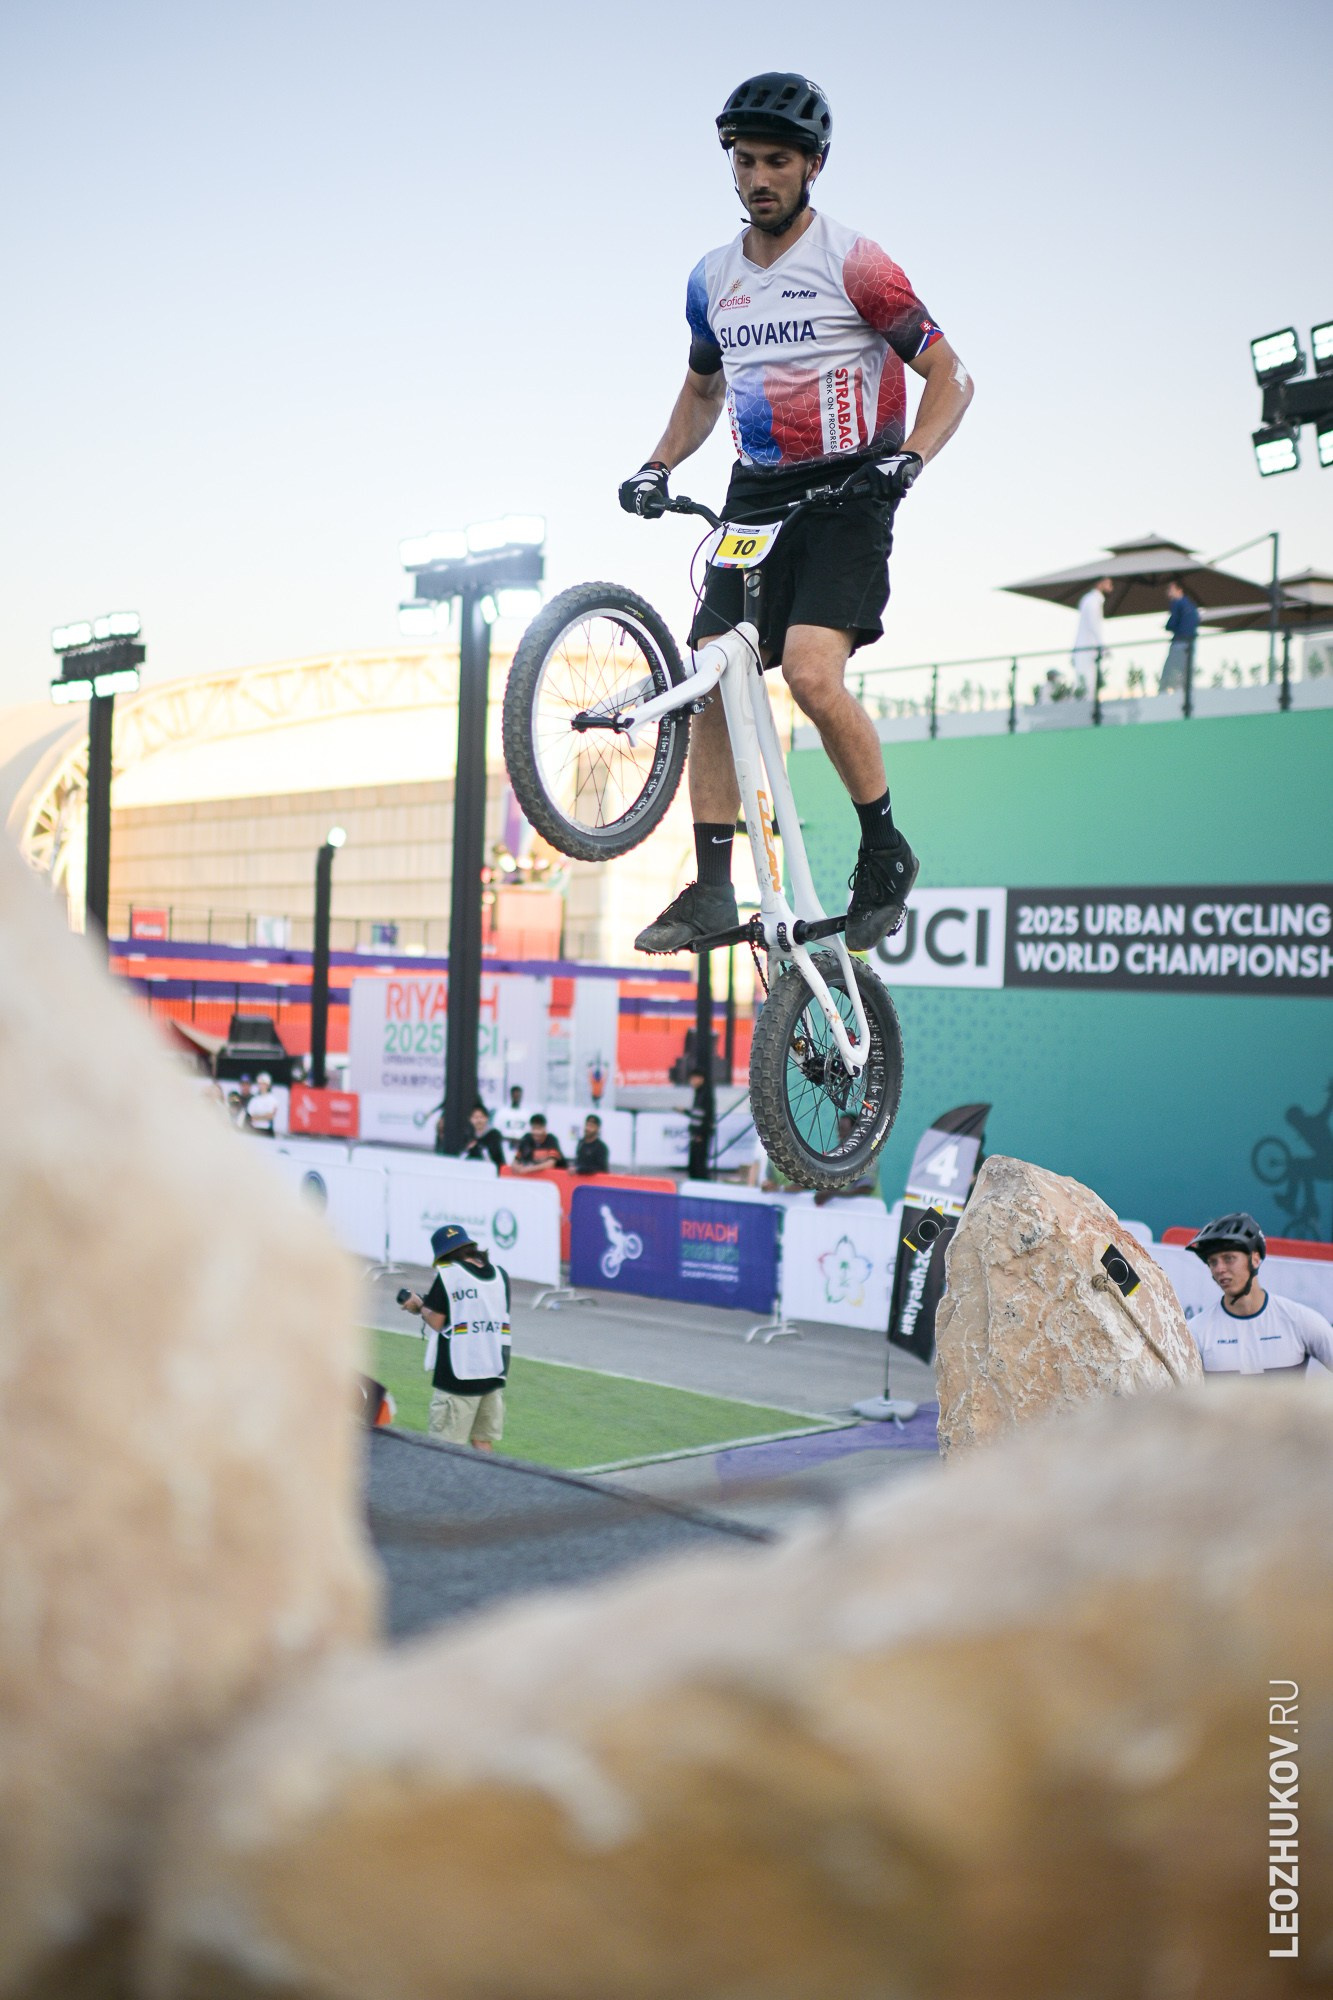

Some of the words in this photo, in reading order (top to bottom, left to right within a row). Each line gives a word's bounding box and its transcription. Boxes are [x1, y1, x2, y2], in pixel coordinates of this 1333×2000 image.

[719, 294, 751, 308] Cofidis
[781, 290, 817, 299] NyNa
[720, 320, 817, 349] SLOVAKIA
[826, 369, 834, 395] WORK
[827, 397, 834, 410] ON
[835, 368, 854, 450] STRABAG
[828, 413, 838, 452] PROGRES
[733, 539, 757, 556] 10
[1016, 906, 1080, 936] 2025
[1084, 903, 1187, 936] URBAN
[1192, 903, 1332, 937] CYCLING
[876, 907, 990, 968] UCI
[1016, 941, 1120, 974] WORLD
[385, 982, 499, 1022] RIYAH
[384, 1023, 445, 1054] 2025
[926, 1144, 960, 1188] 4
[922, 1194, 950, 1210] UCI
[681, 1219, 739, 1244] RIYADH
[455, 1288, 478, 1301] UCI
[901, 1242, 934, 1336] #Riyadh20
